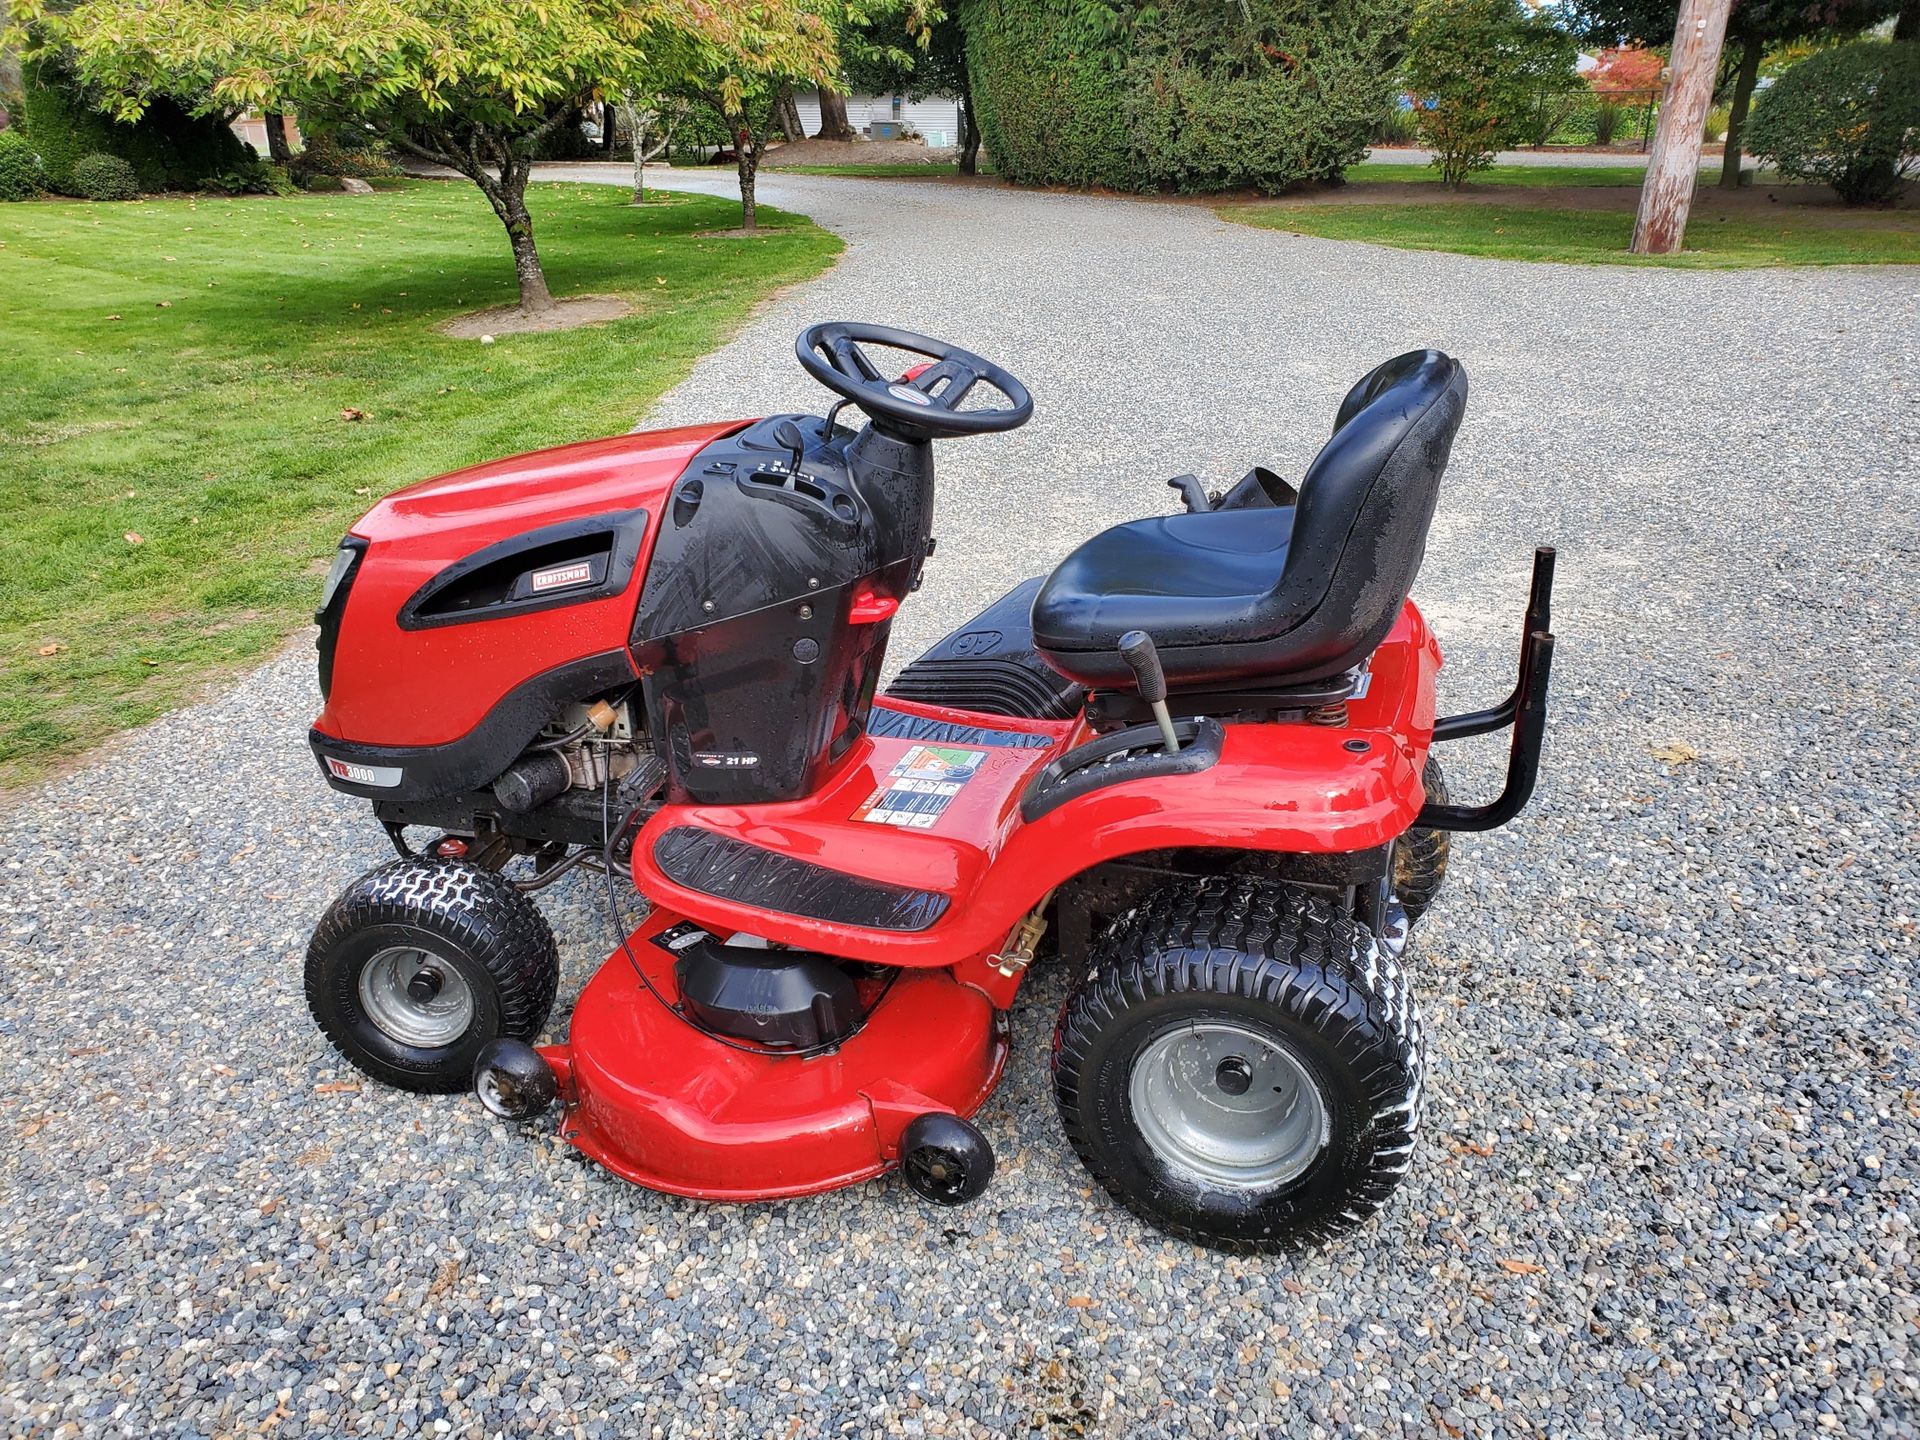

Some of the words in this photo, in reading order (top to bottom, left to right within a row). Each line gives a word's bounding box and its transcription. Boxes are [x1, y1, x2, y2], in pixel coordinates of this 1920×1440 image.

[536, 567, 587, 585] CRAFTSMAN
[726, 757, 739, 765] 21
[741, 757, 758, 765] HP
